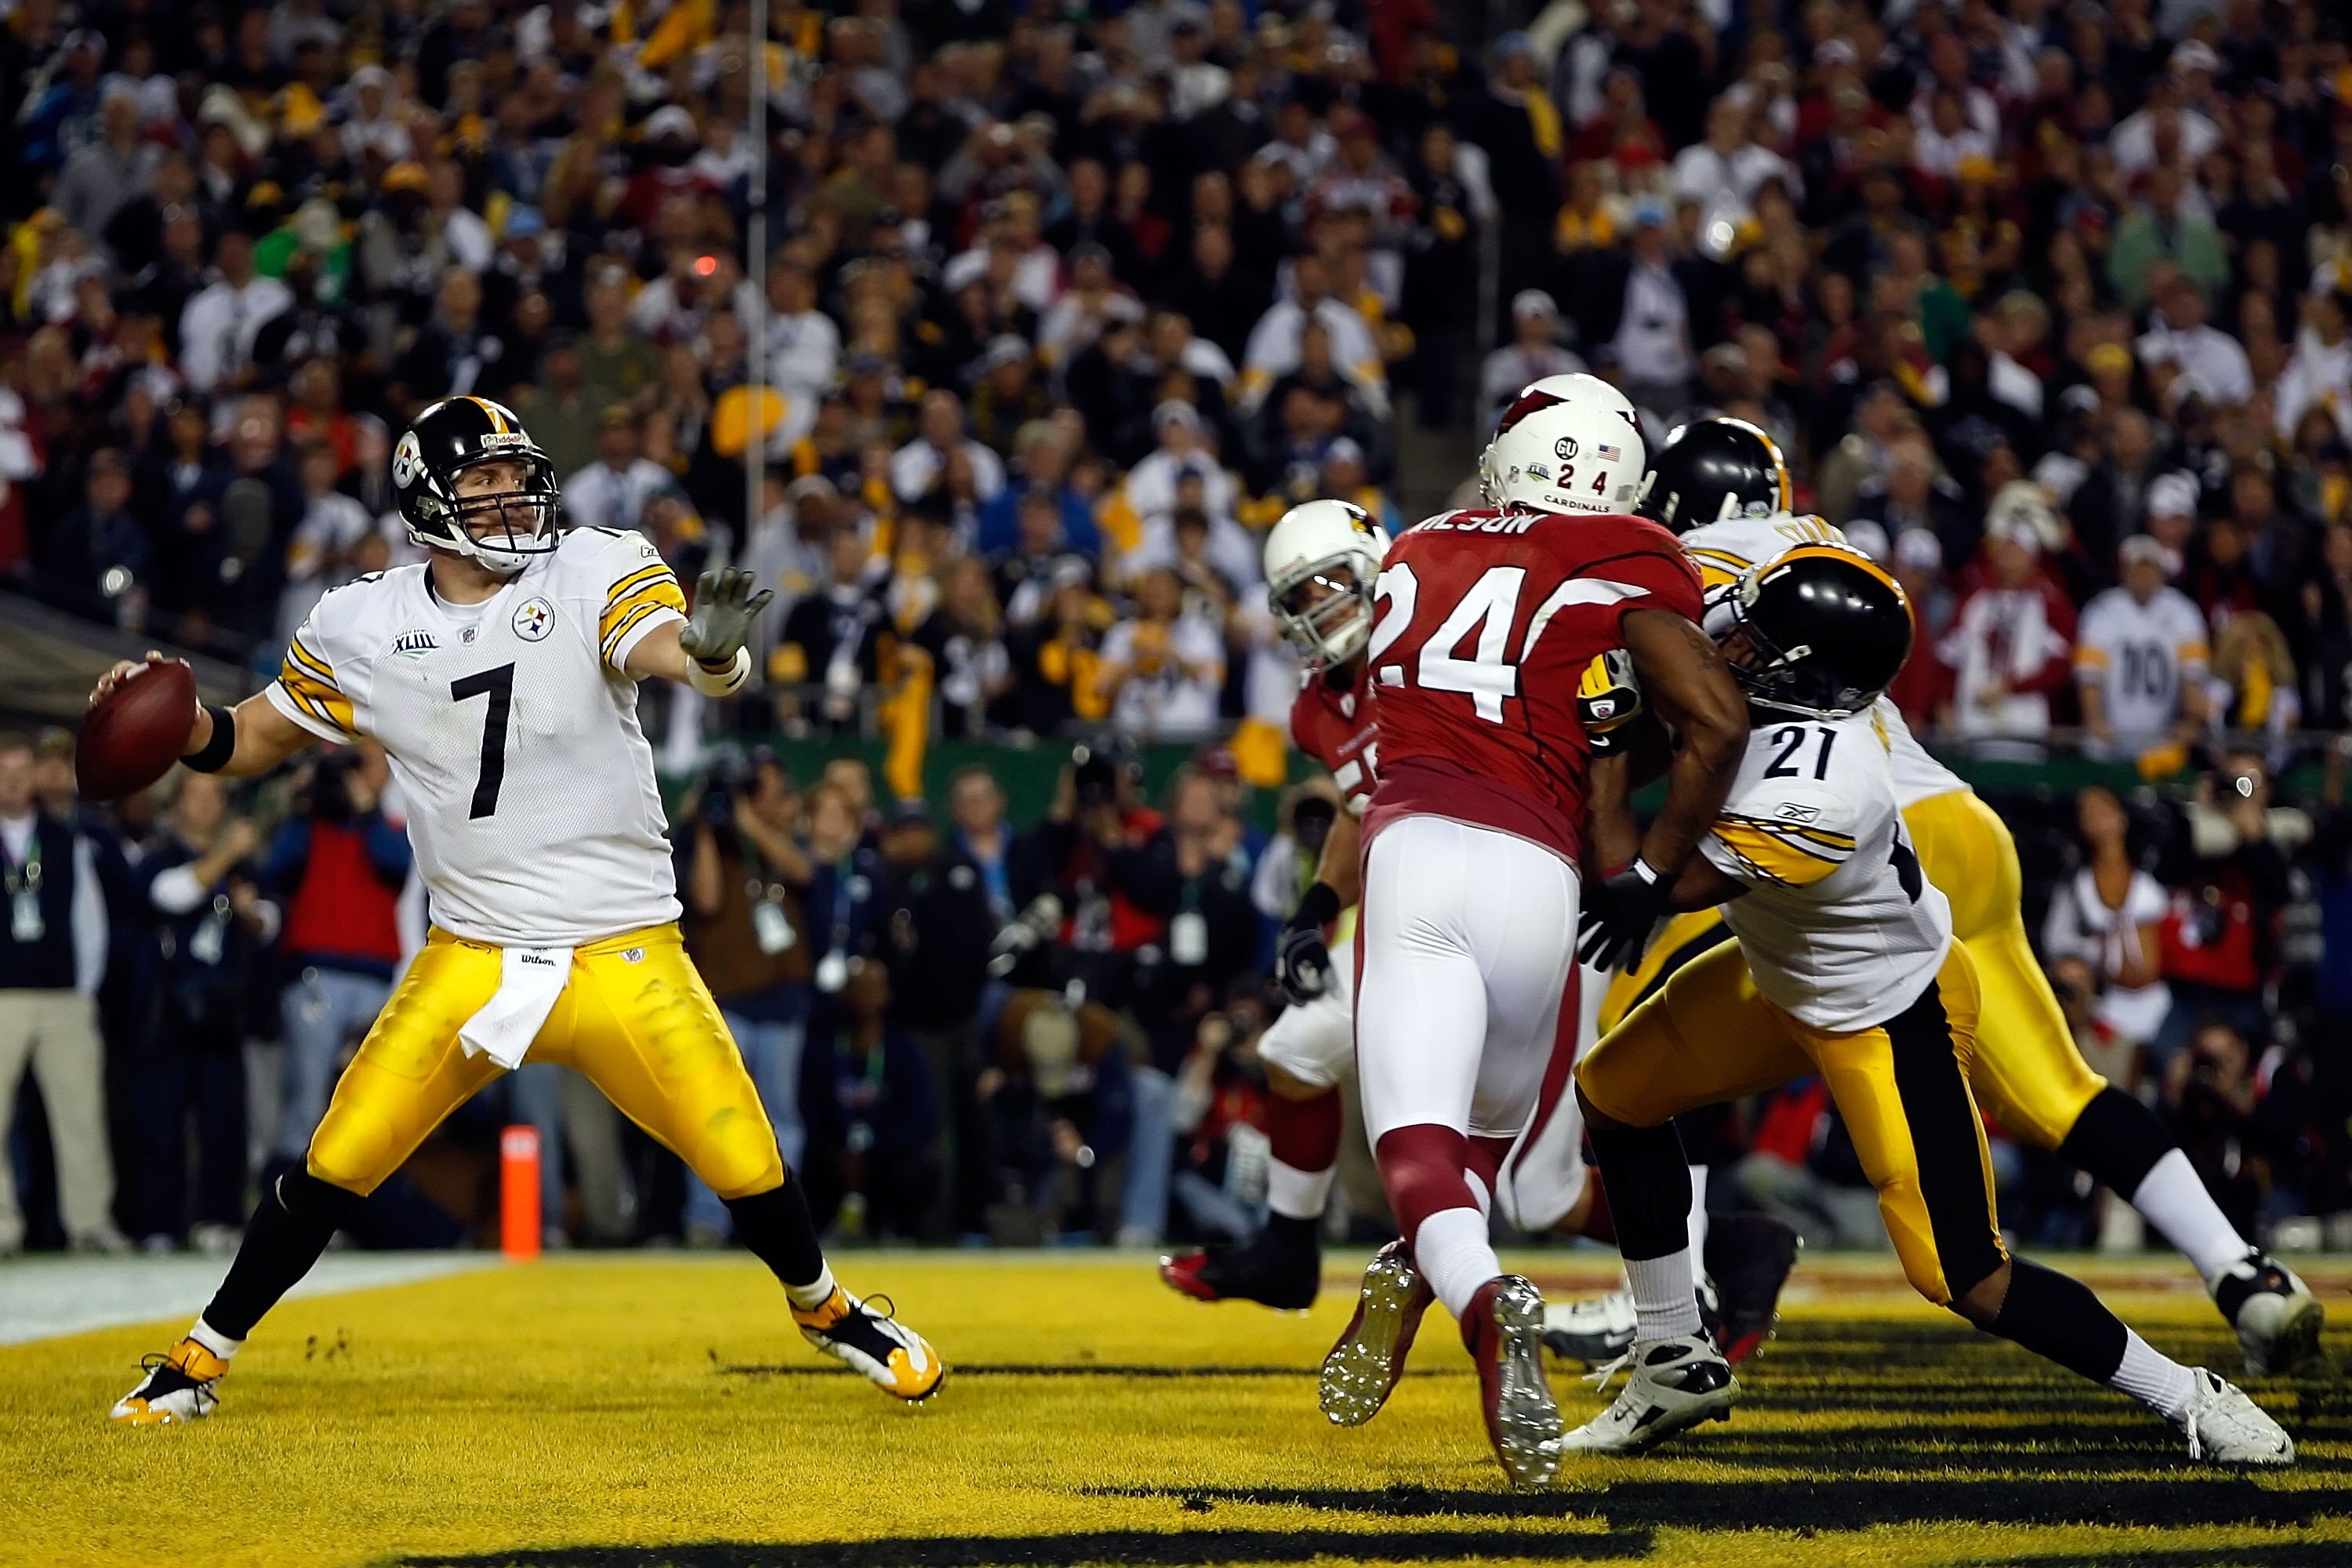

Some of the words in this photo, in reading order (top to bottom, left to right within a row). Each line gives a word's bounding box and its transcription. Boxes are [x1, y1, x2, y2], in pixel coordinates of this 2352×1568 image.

[1556, 440, 1577, 456] GU
[1544, 495, 1611, 514] CARDINALS
[392, 633, 439, 655] XLIII
[1369, 561, 1526, 724] 24
[451, 661, 516, 821] 7
[1763, 726, 1838, 781] 21
[521, 954, 555, 967] Wilson
